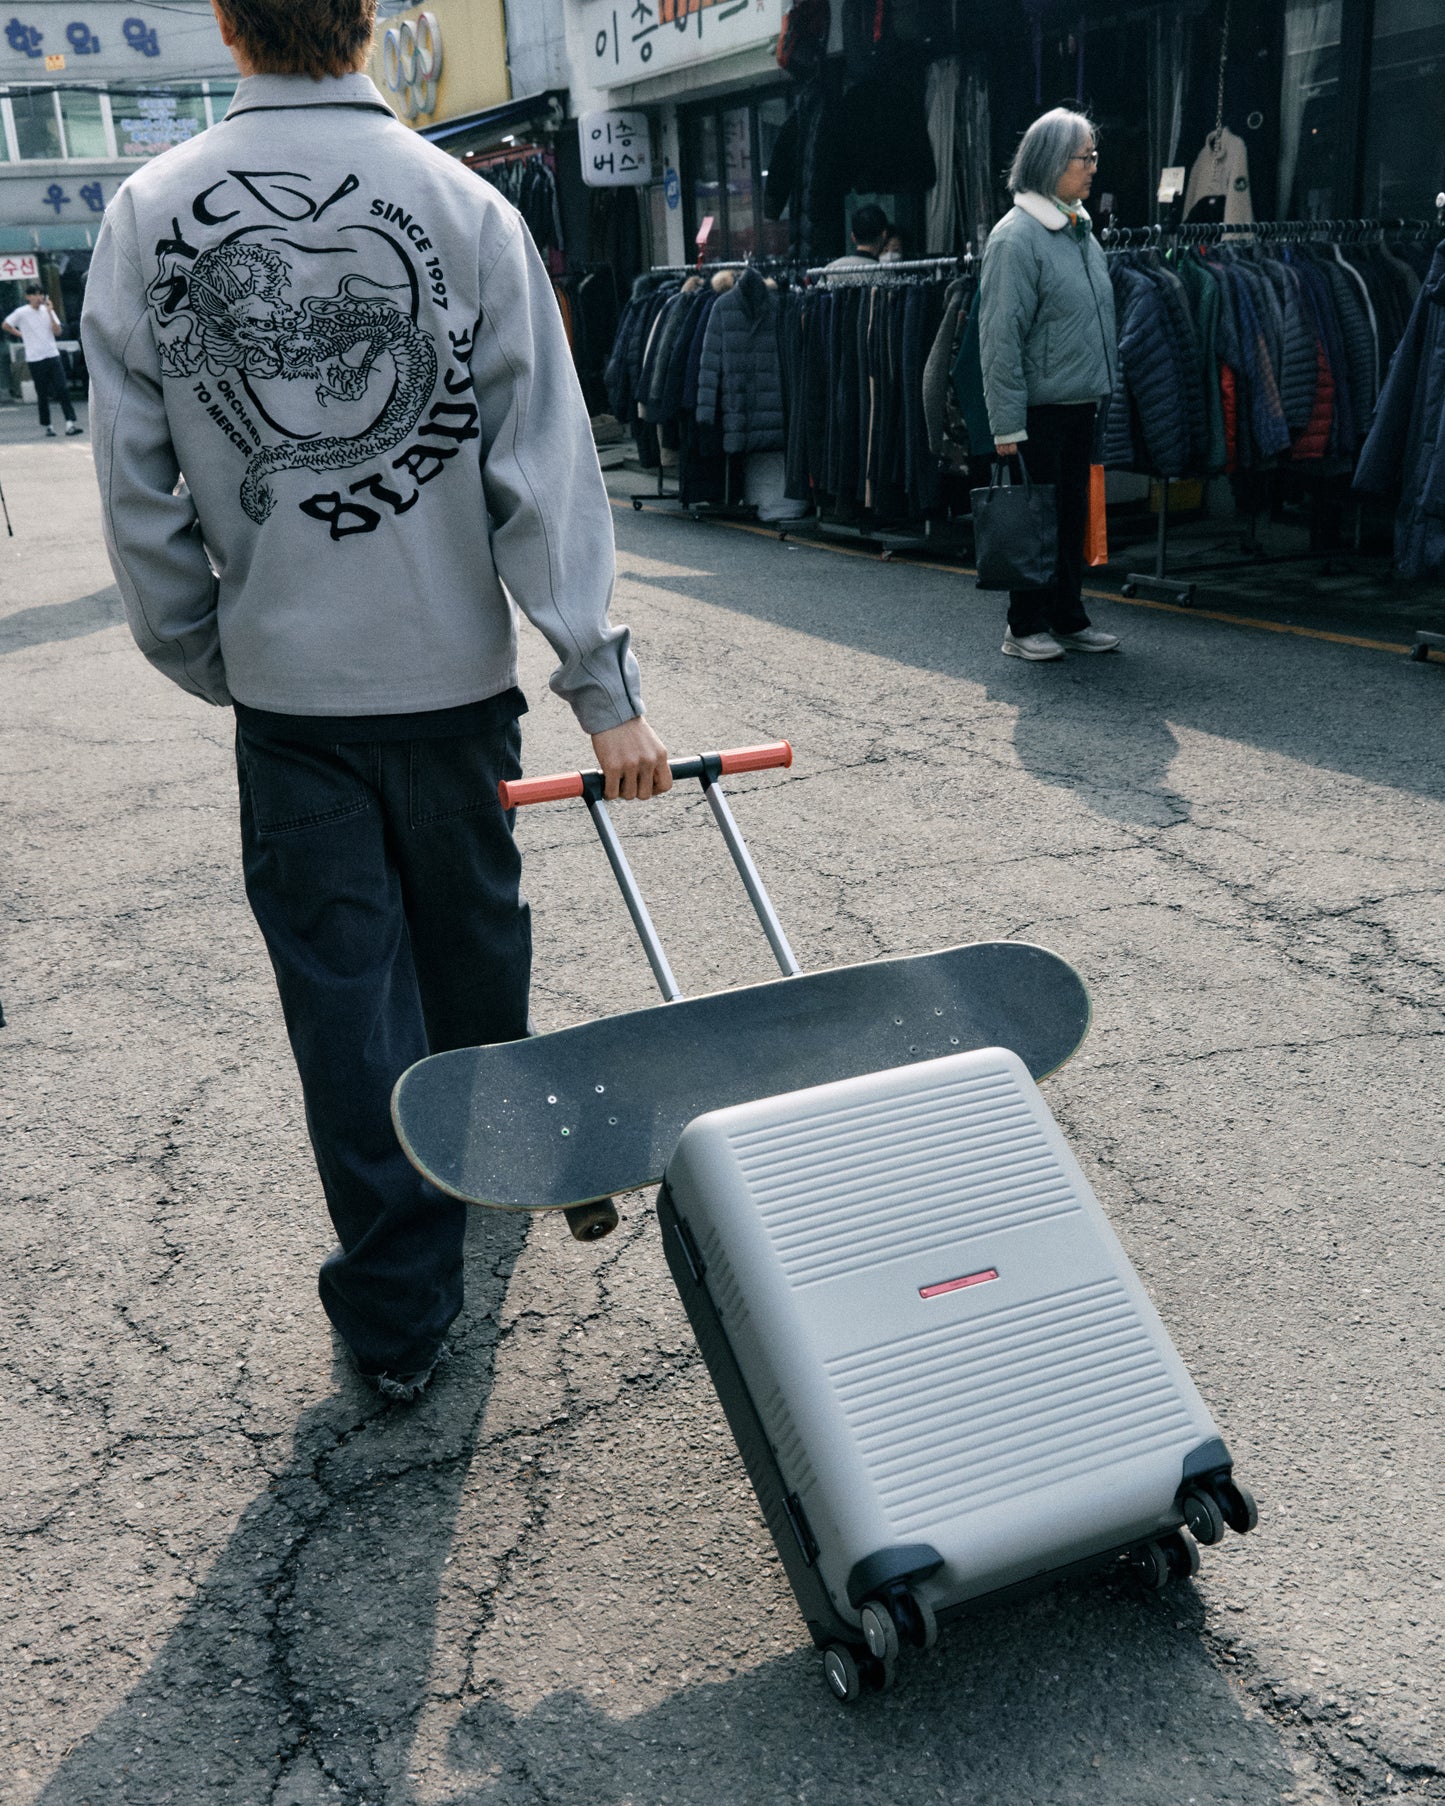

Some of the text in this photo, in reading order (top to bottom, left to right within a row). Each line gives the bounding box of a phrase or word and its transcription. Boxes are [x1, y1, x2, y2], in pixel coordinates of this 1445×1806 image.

[593, 152, 640, 174] 버스
[0, 257, 36, 277] 수선
[370, 198, 449, 311] SINCE 1997
[193, 381, 253, 458] TO MERCER
[217, 379, 262, 447] ORCHARD
